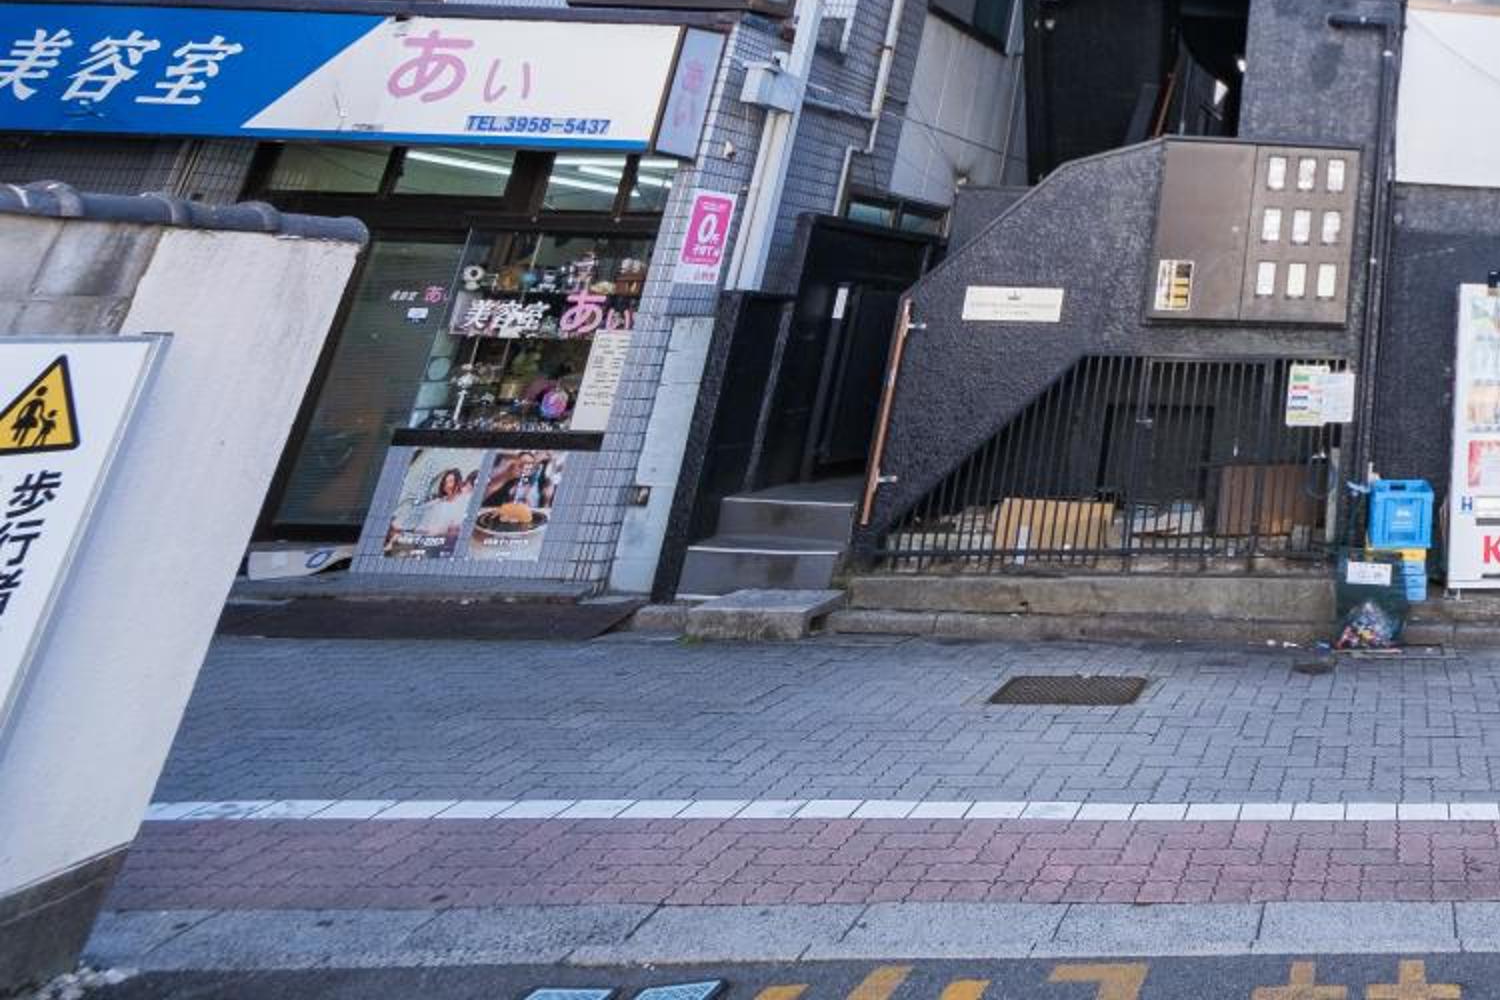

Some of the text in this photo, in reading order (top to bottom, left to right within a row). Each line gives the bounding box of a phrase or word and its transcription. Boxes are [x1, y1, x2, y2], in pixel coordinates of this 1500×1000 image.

[0, 28, 532, 105] 美容室 あい
[462, 288, 634, 334] 美容室 あい
